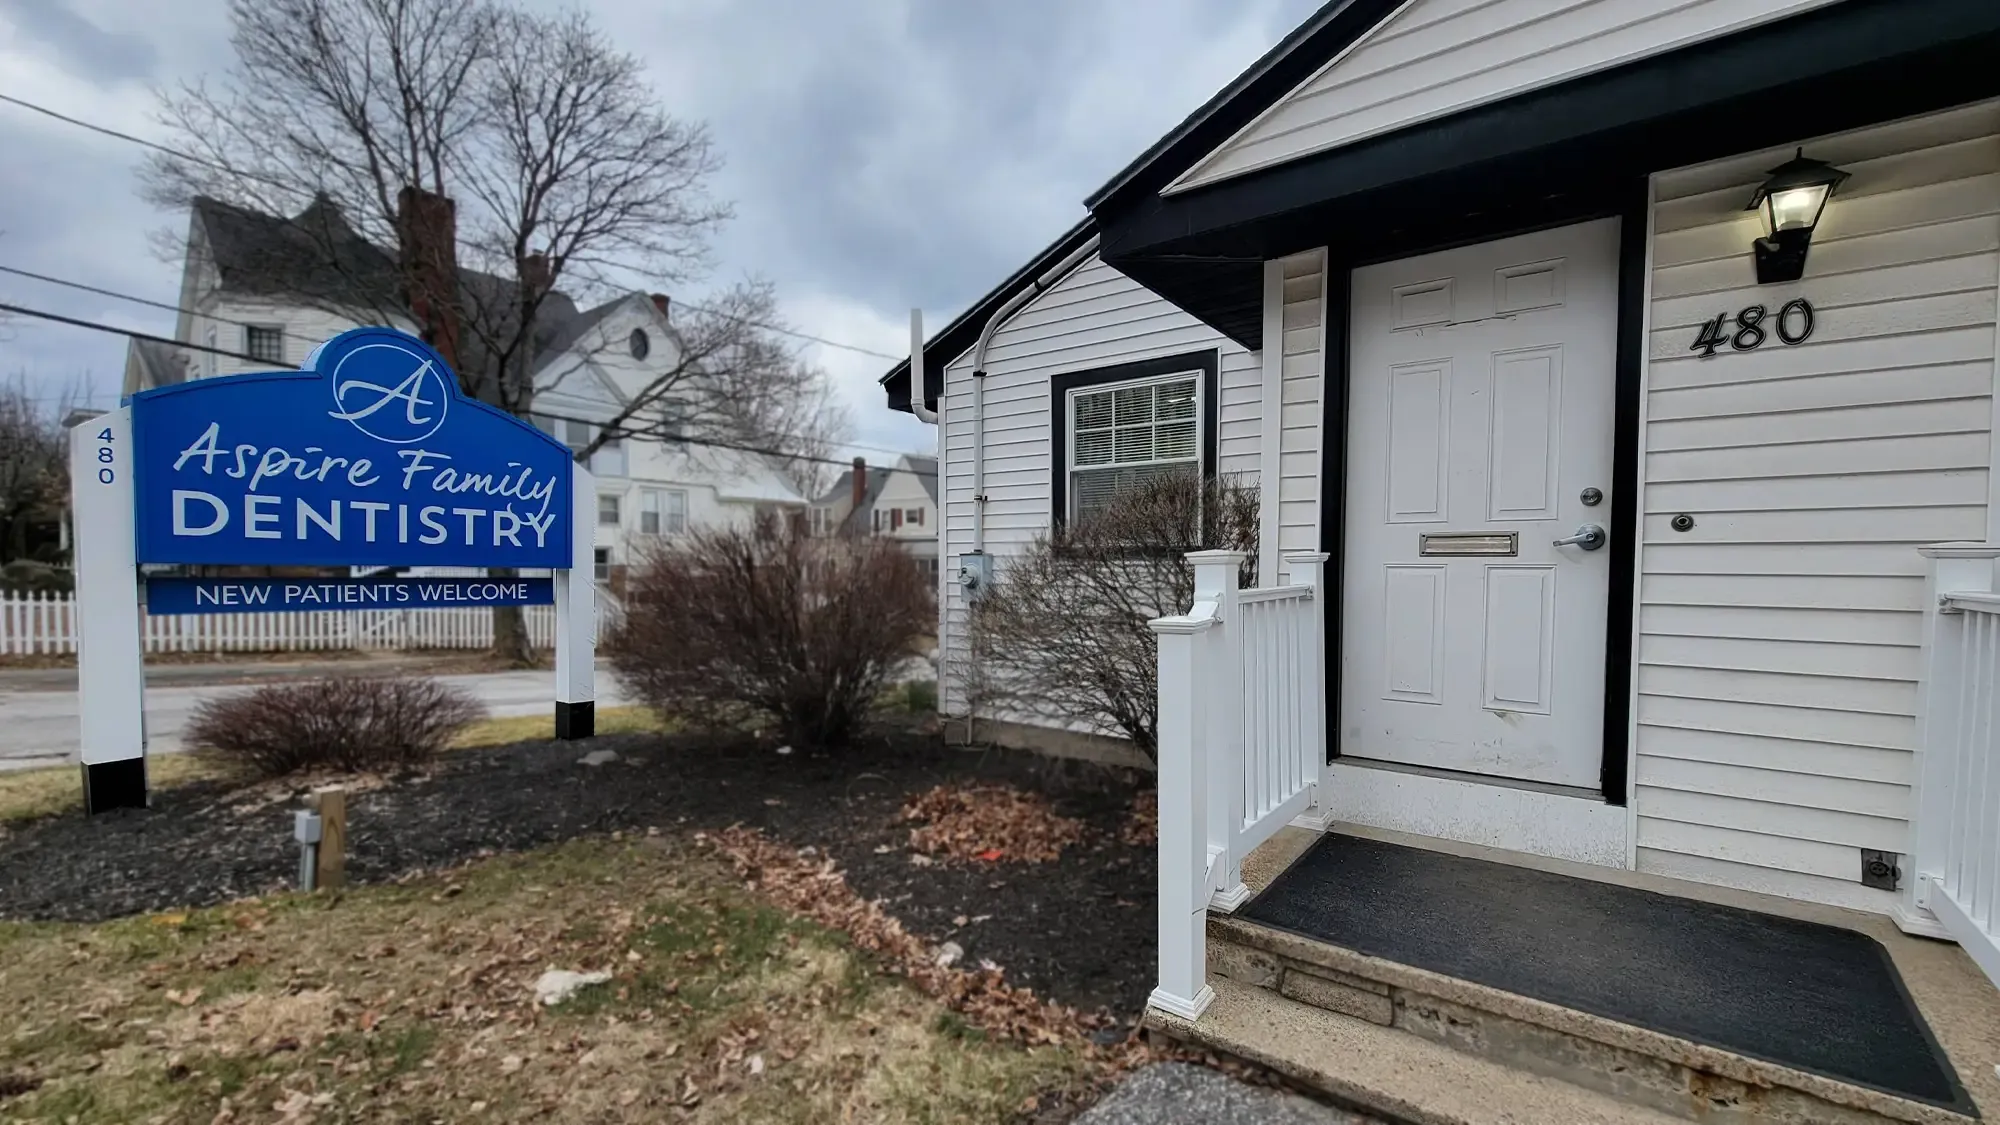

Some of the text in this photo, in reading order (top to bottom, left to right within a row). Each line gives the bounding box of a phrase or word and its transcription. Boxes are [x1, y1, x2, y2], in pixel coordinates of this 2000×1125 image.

[1689, 297, 1816, 359] 480
[97, 427, 115, 485] 480
[172, 421, 557, 525] Aspire Family
[172, 489, 557, 548] DENTISTRY
[195, 582, 528, 606] NEW PATIENTS WELCOME
